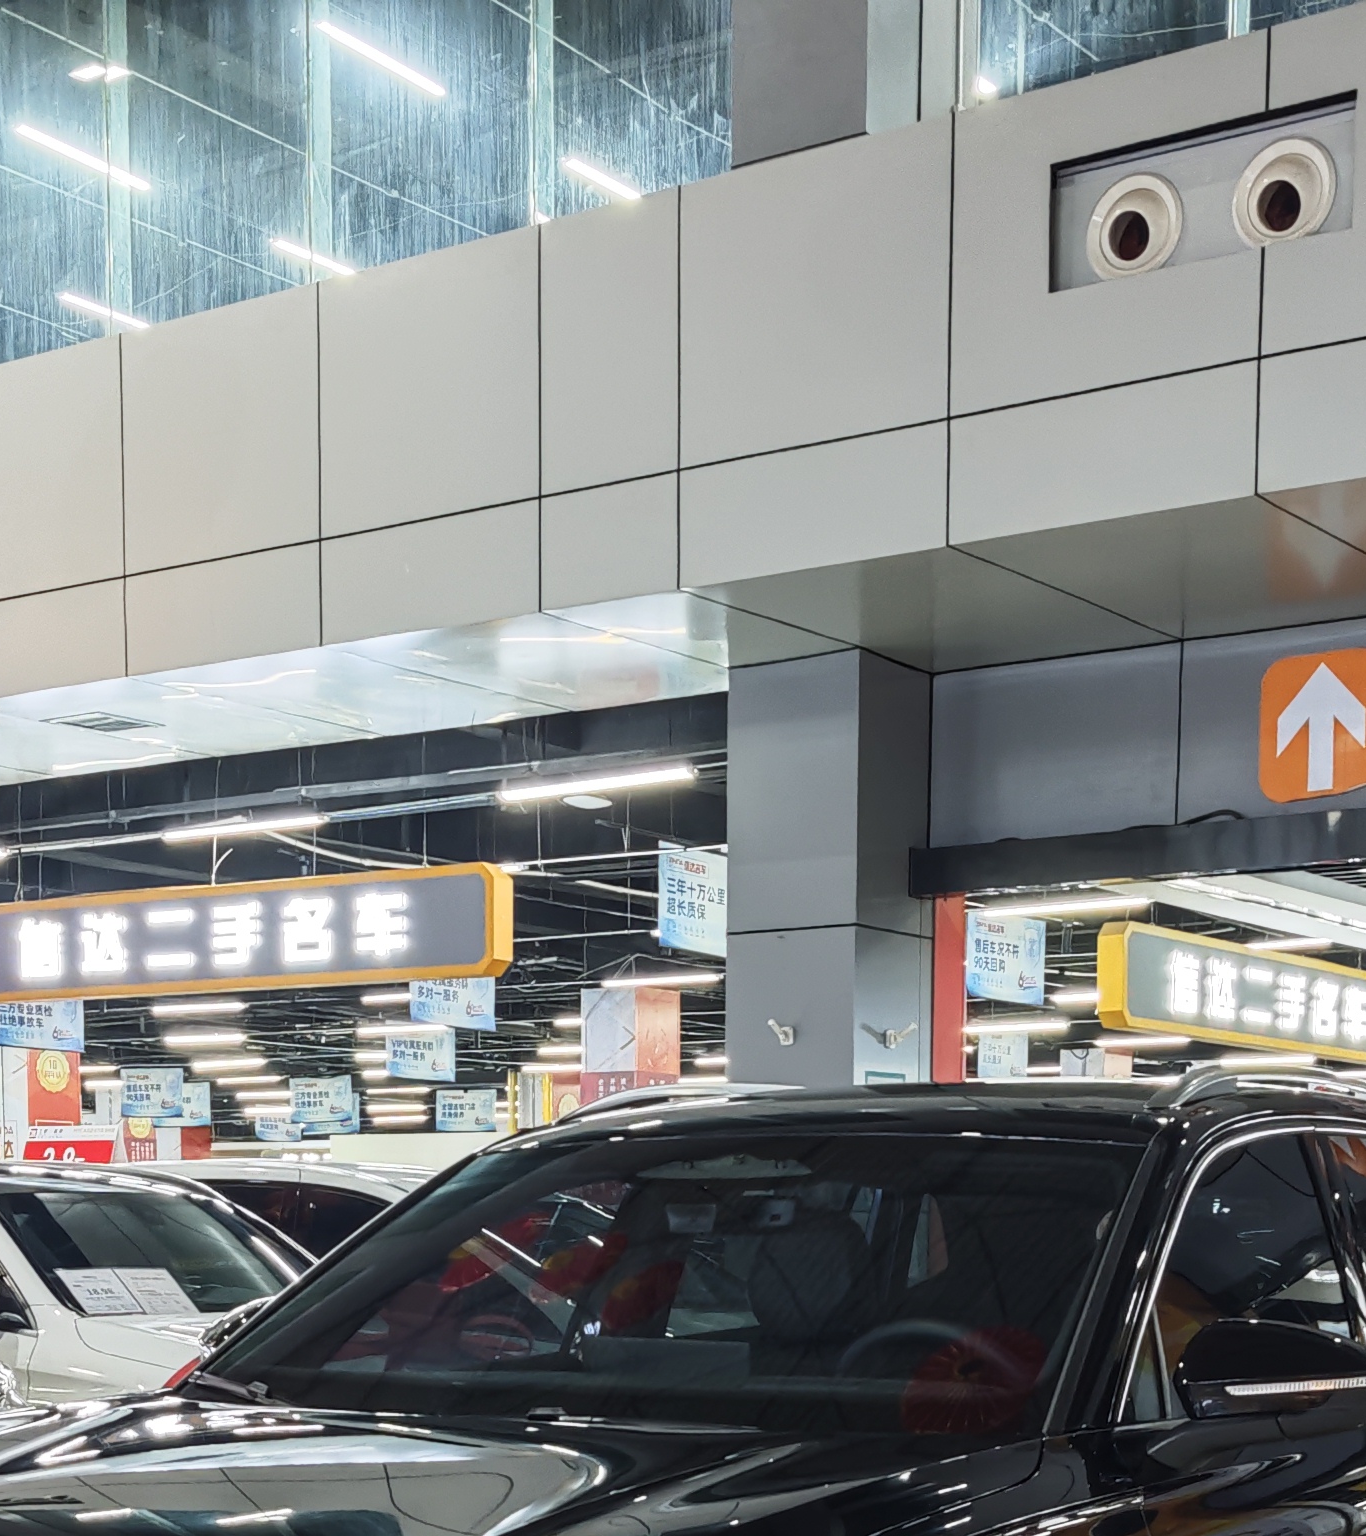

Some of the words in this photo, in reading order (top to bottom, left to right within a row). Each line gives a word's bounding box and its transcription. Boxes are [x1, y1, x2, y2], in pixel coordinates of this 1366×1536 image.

[667, 877, 725, 906] 三年十万公里
[667, 897, 706, 920] 超长质保
[17, 892, 410, 982] 信达二手名车
[974, 938, 1020, 960] 售后车况不符
[973, 957, 1006, 974] 90天回购
